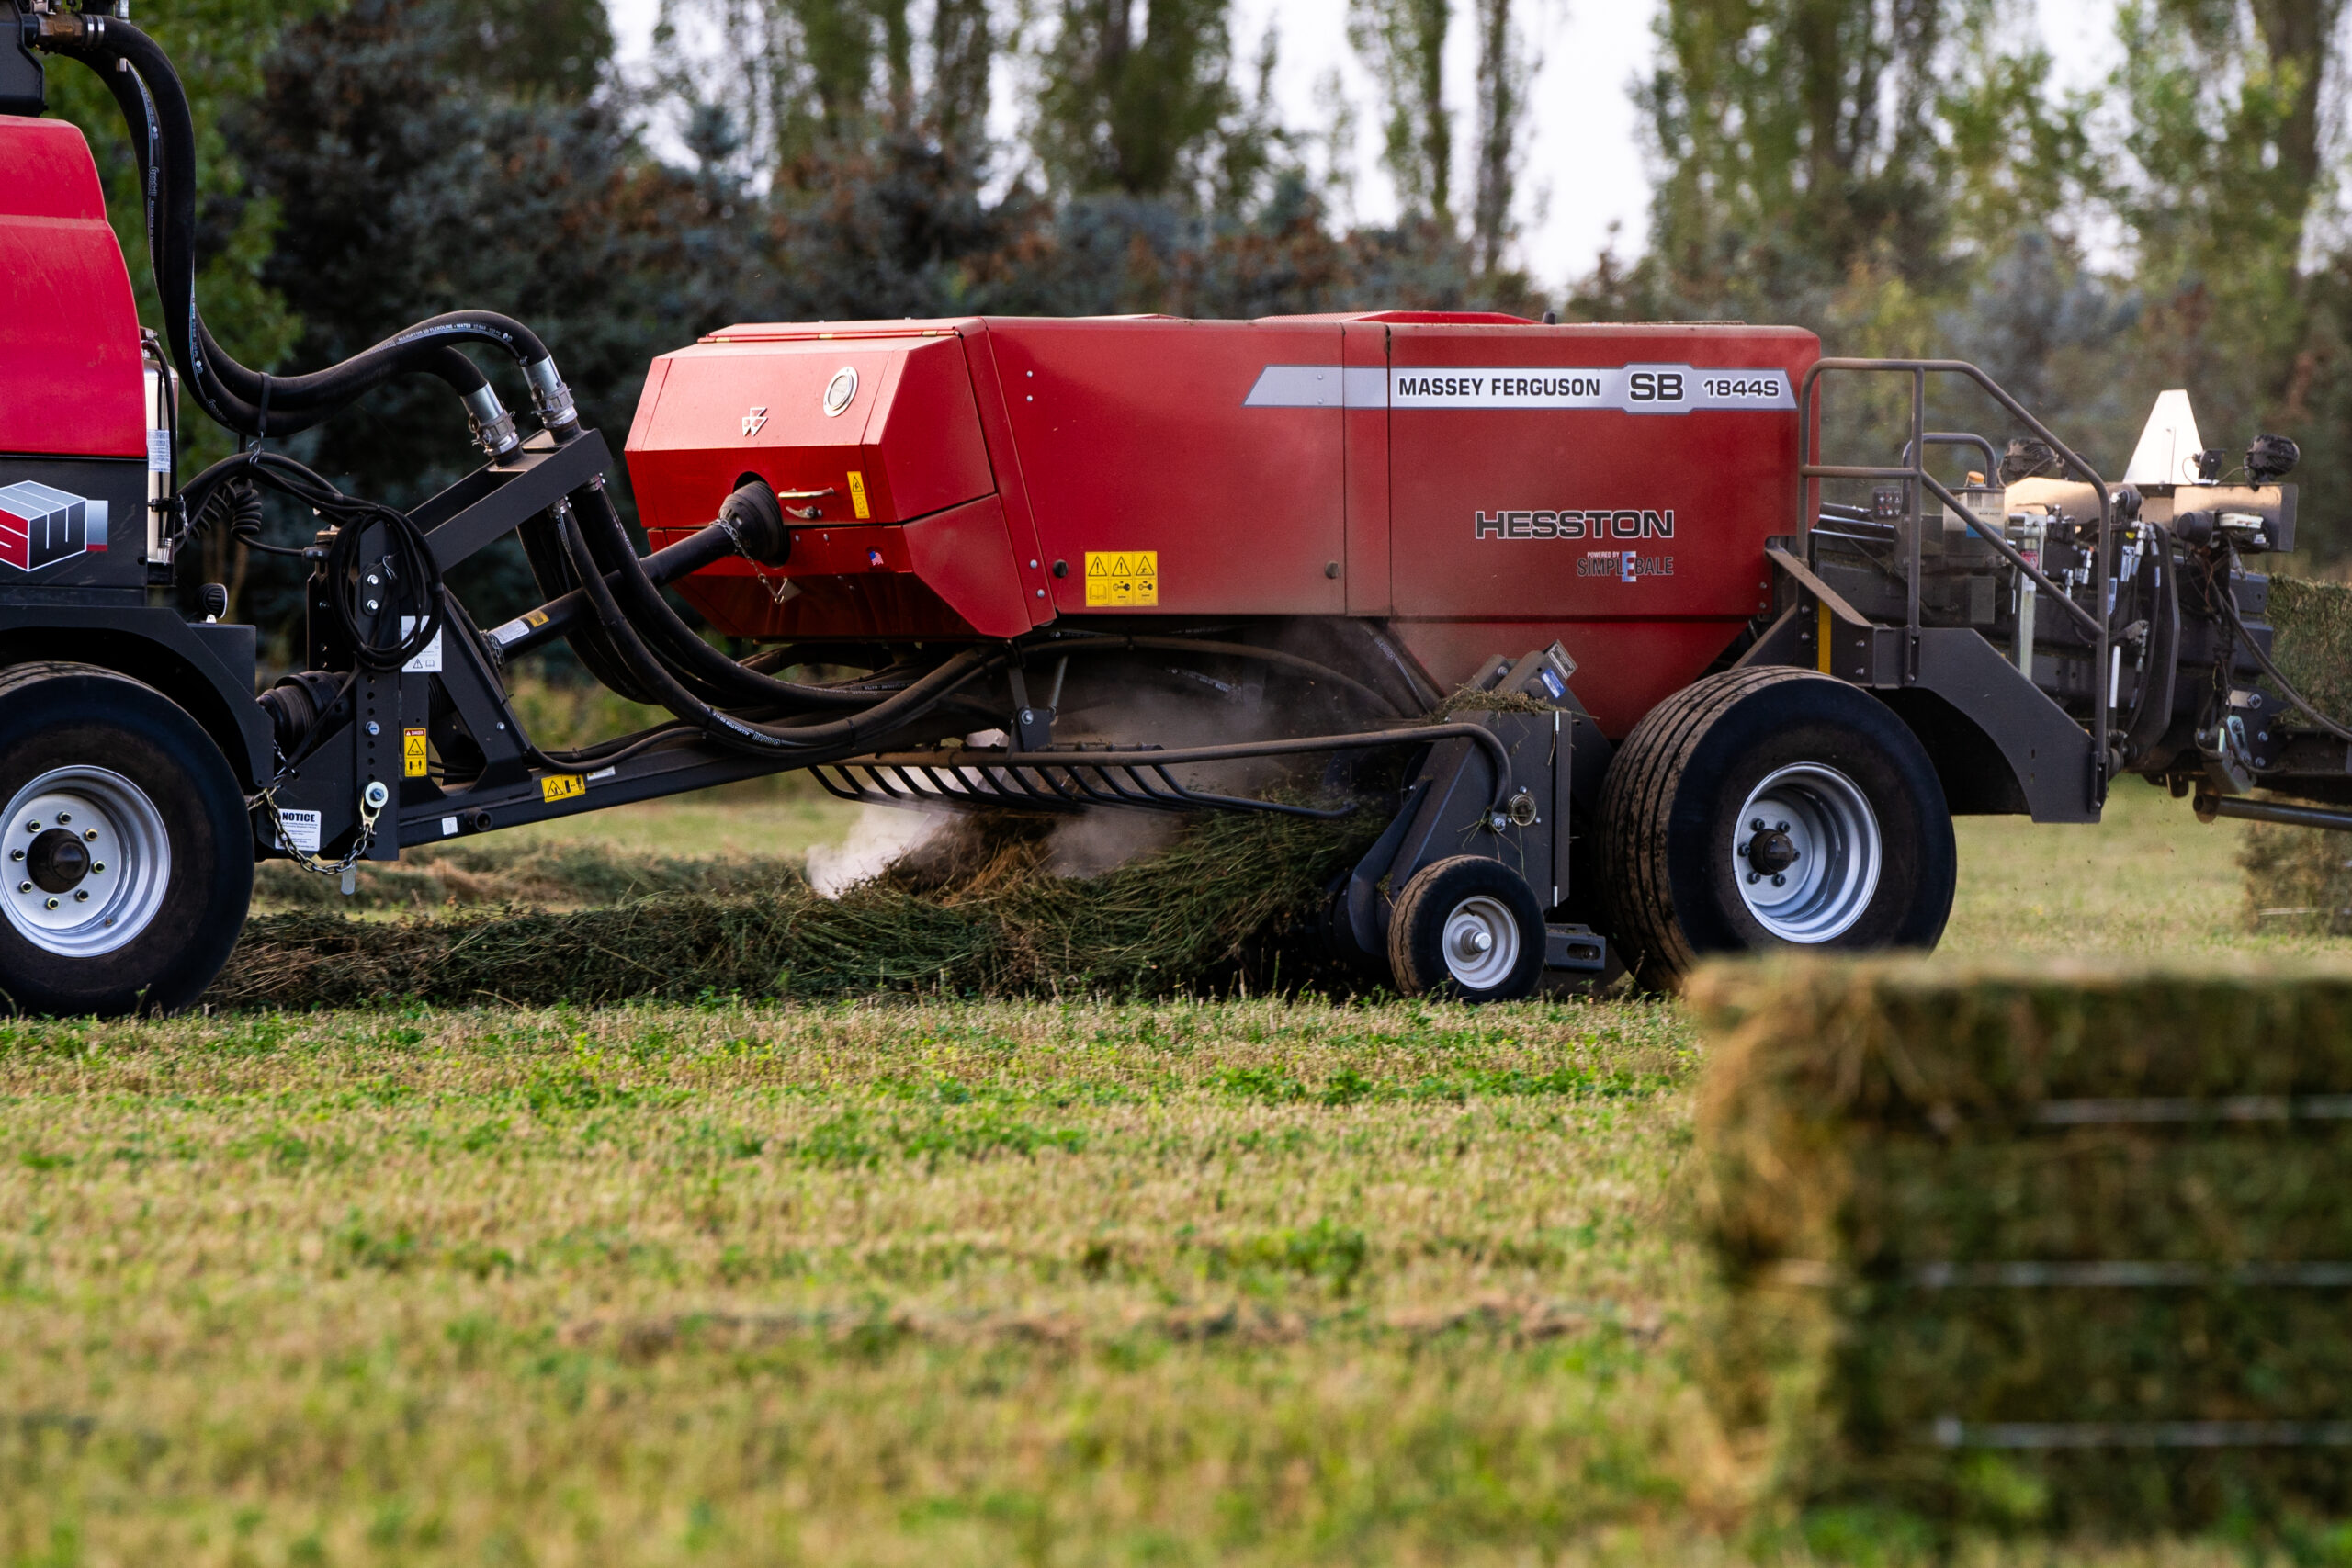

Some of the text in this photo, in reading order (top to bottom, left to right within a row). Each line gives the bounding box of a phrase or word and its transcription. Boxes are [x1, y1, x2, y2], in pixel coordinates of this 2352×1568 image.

[1398, 378, 1600, 397] MASSEY FERGUSON
[1630, 373, 1779, 400] SB 1844S
[1476, 510, 1674, 539] HESSTON
[282, 812, 315, 822] NOTICE
